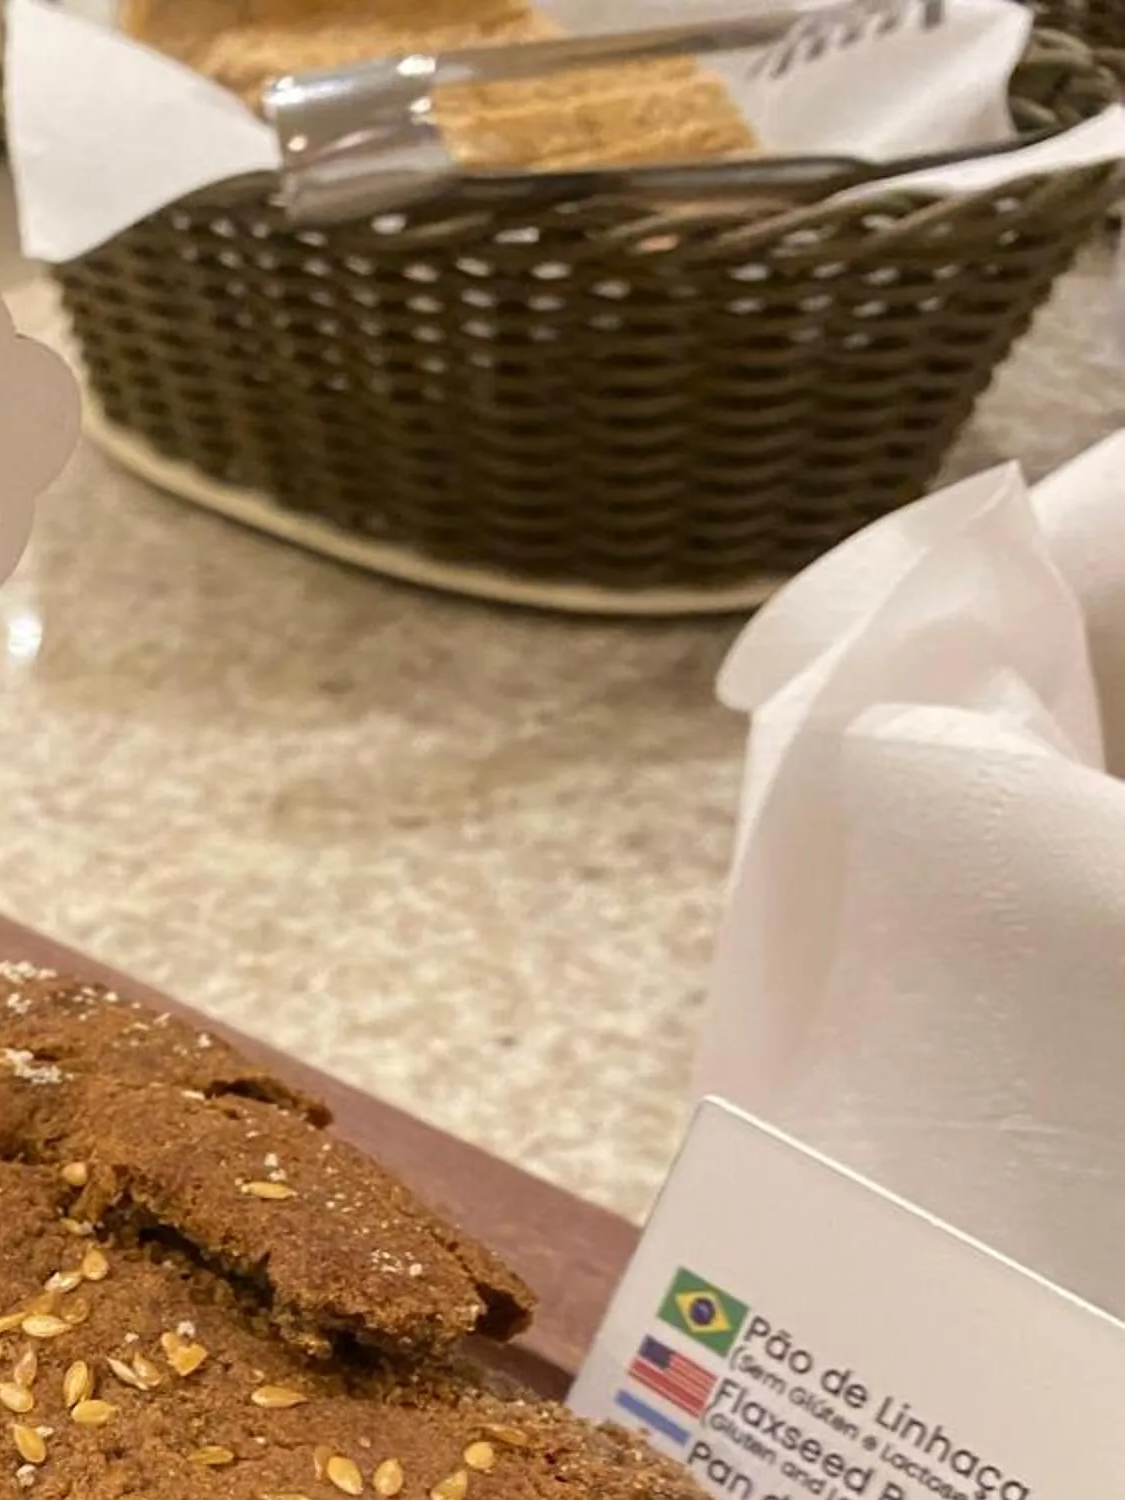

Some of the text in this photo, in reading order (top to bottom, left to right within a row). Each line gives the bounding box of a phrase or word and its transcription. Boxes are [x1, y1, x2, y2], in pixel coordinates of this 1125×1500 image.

[729, 1345, 787, 1395] (Sem
[744, 1315, 813, 1374] Pão
[820, 1368, 868, 1409] de
[713, 1377, 874, 1495] Flaxseed
[688, 1440, 752, 1500] Pan
[781, 1461, 827, 1495] and
